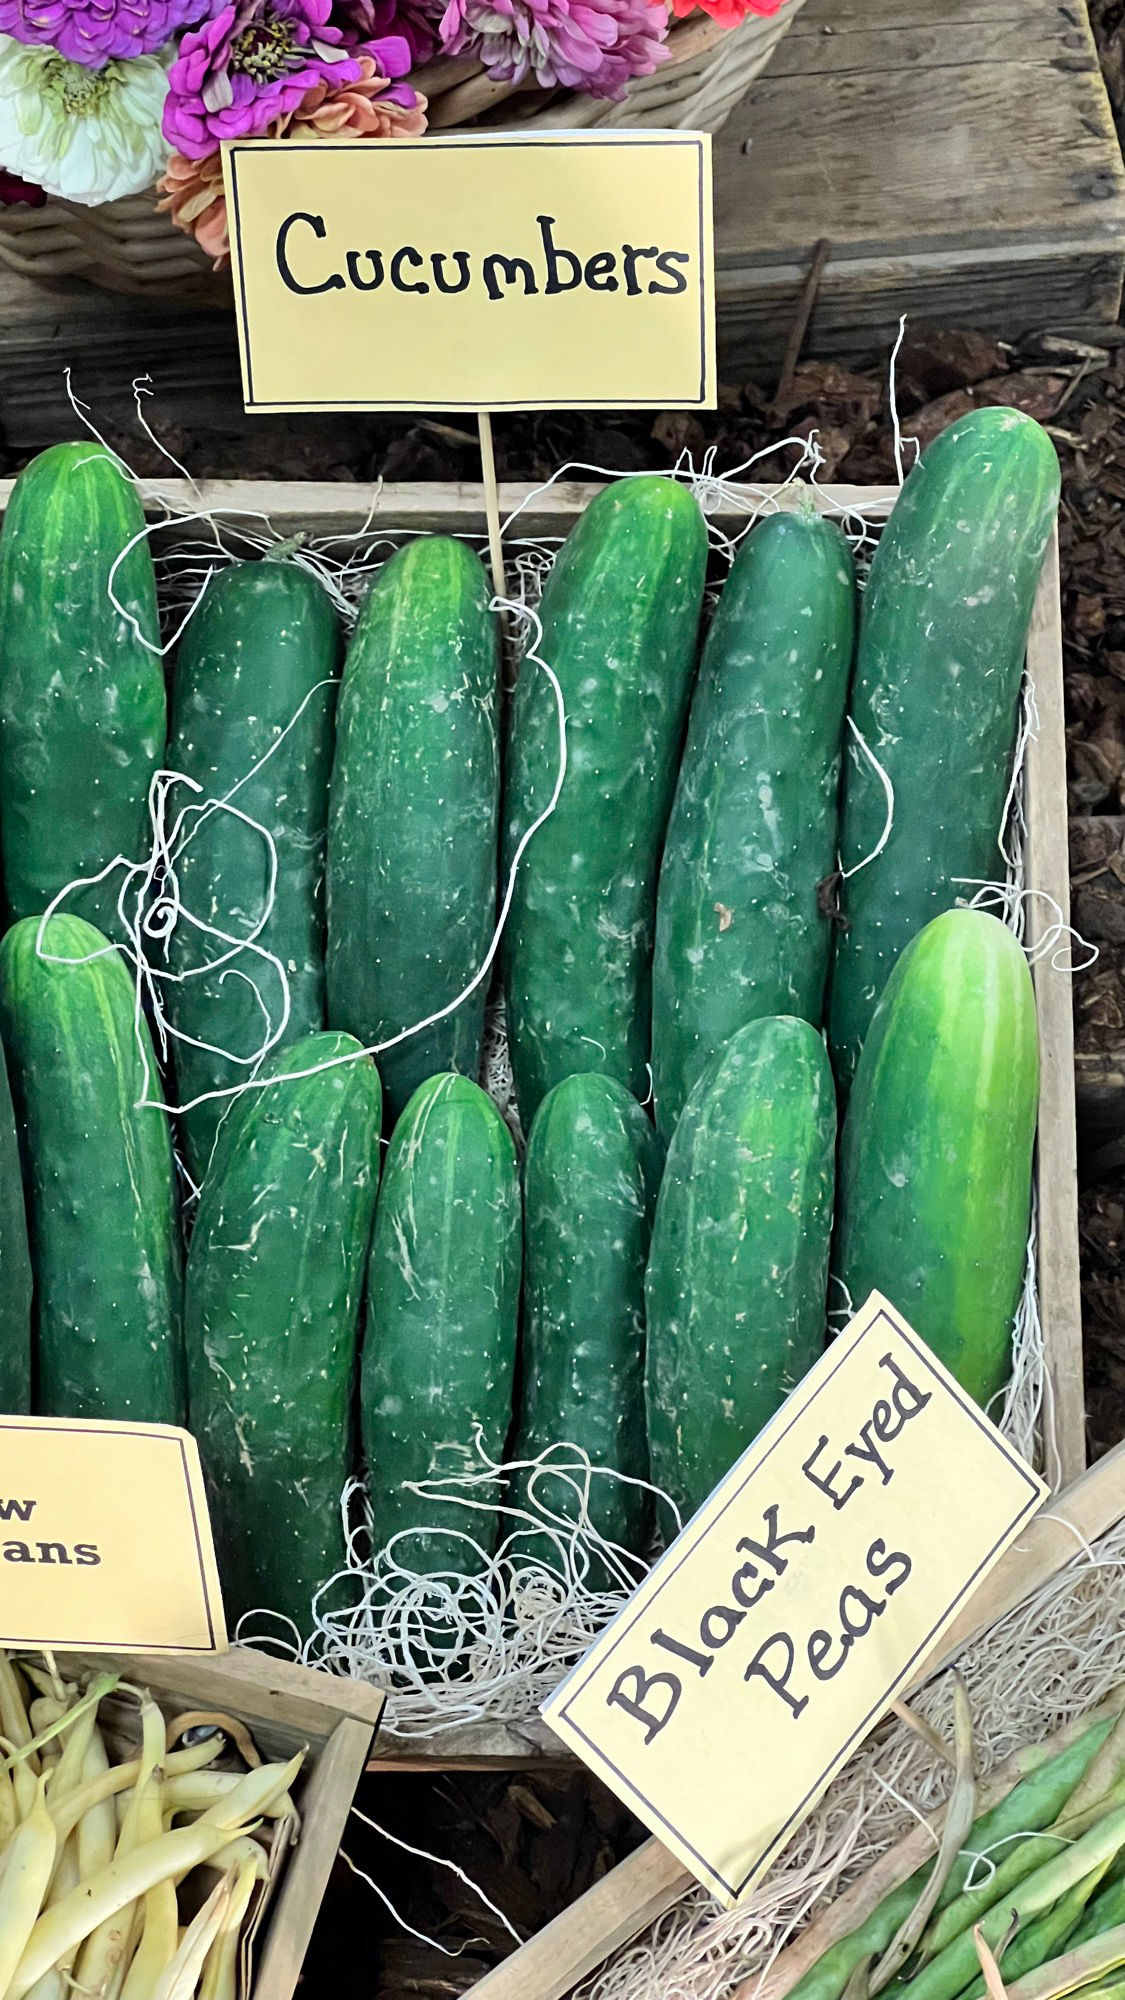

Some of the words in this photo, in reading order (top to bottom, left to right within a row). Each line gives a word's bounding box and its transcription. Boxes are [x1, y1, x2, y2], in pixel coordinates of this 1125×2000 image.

[276, 212, 690, 300] Cucumbers
[801, 1352, 933, 1511] Eyed
[743, 1537, 913, 1720] Peas
